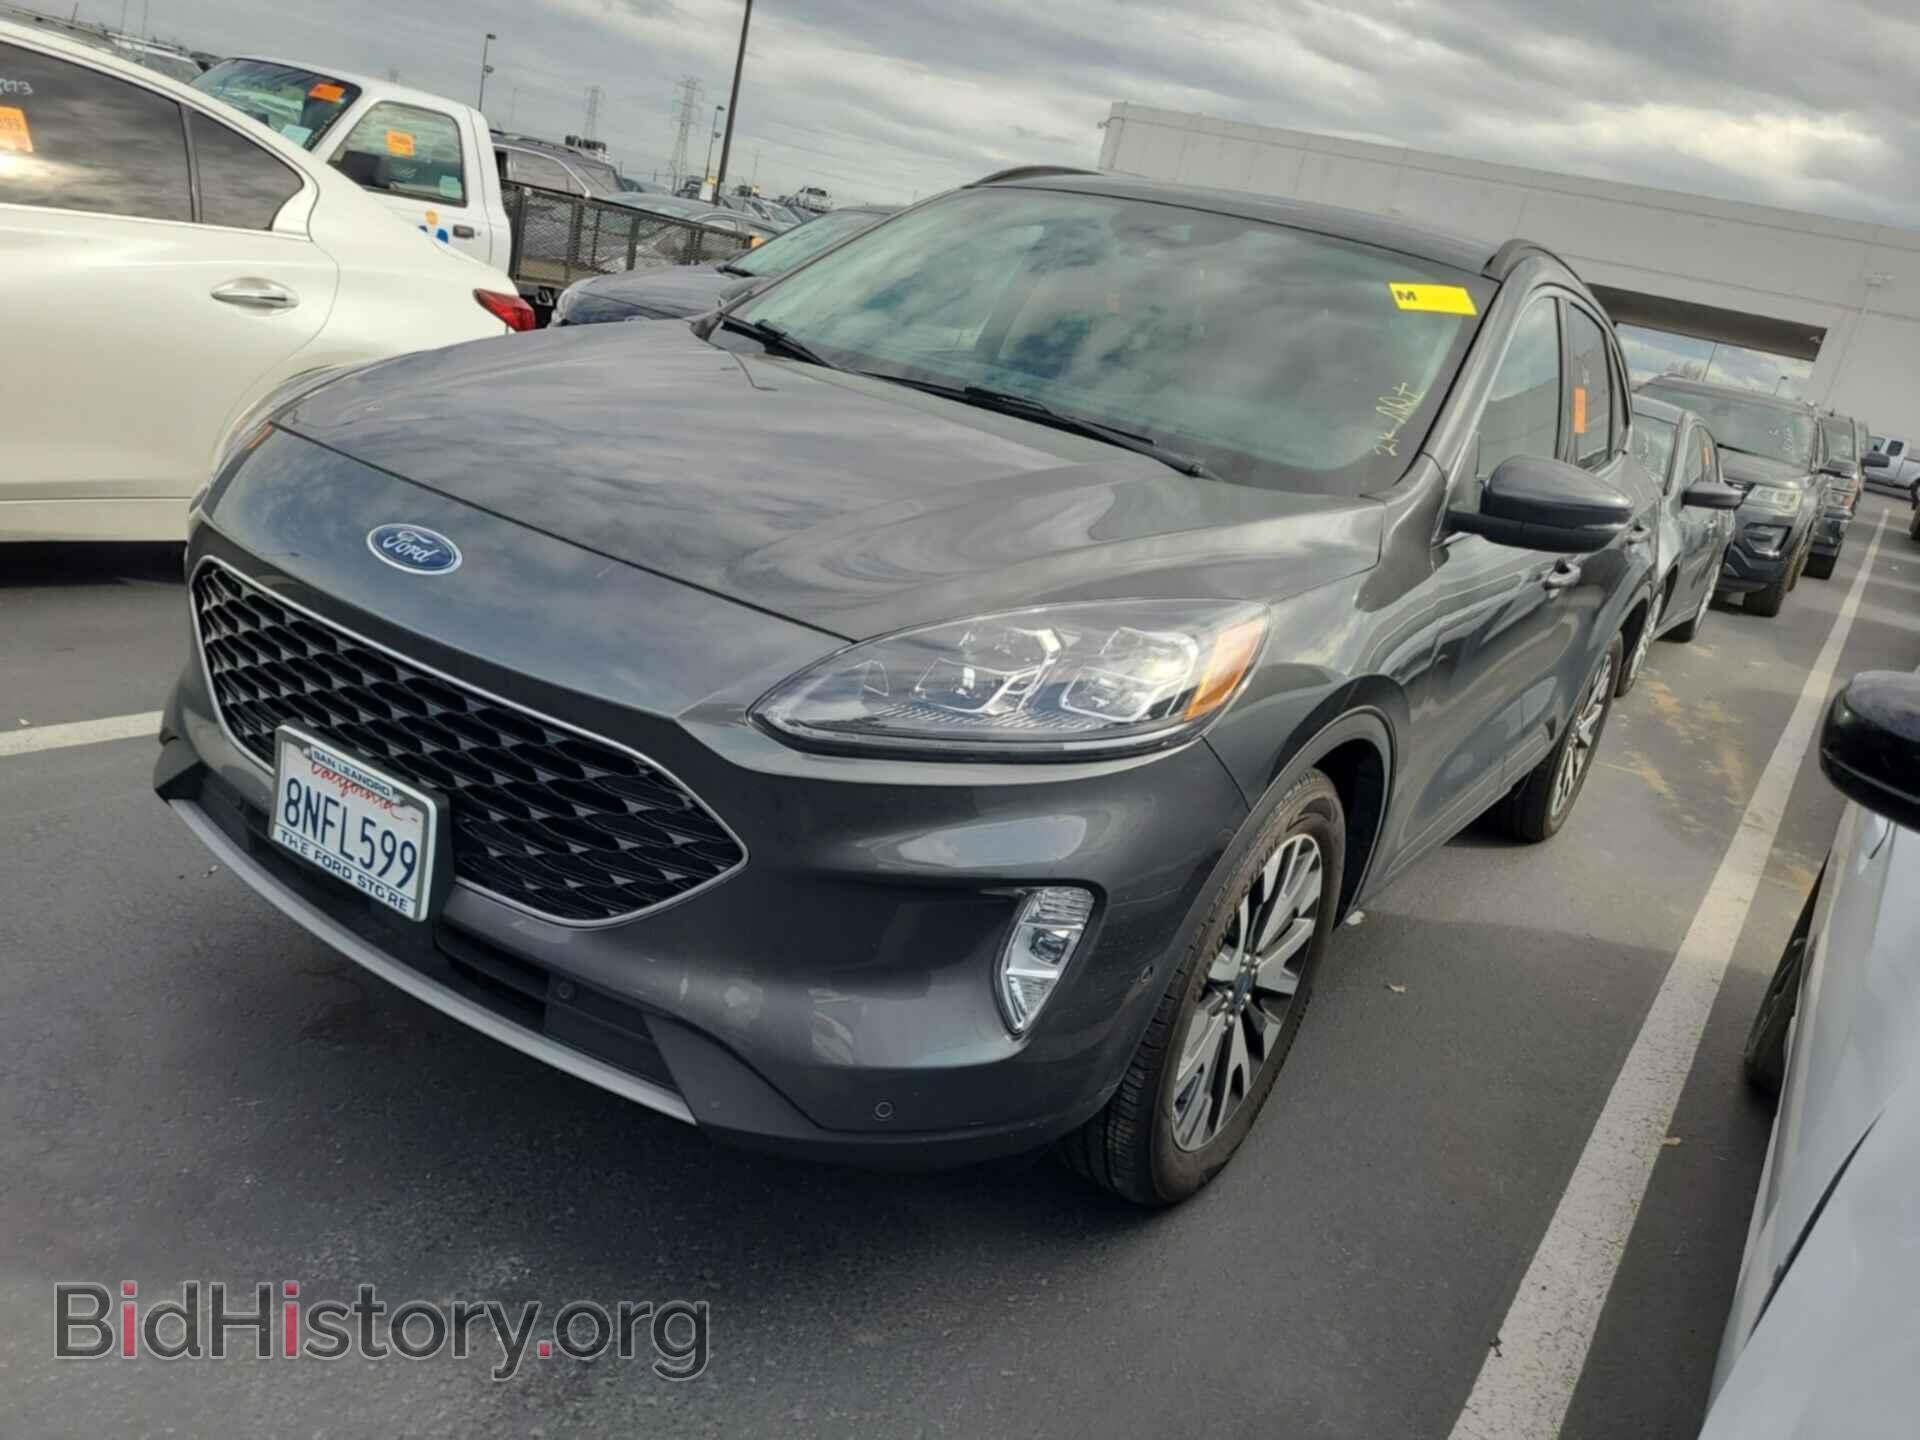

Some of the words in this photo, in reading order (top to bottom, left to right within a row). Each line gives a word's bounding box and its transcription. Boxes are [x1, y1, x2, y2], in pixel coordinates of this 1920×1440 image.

[1395, 289, 1418, 302] M
[382, 530, 441, 563] Ford
[312, 750, 337, 770] SAN
[338, 763, 391, 797] LEANDRO
[284, 777, 417, 889] 8NFL599
[281, 829, 309, 856] THE
[314, 849, 353, 880] FORD
[357, 873, 409, 913] STORE
